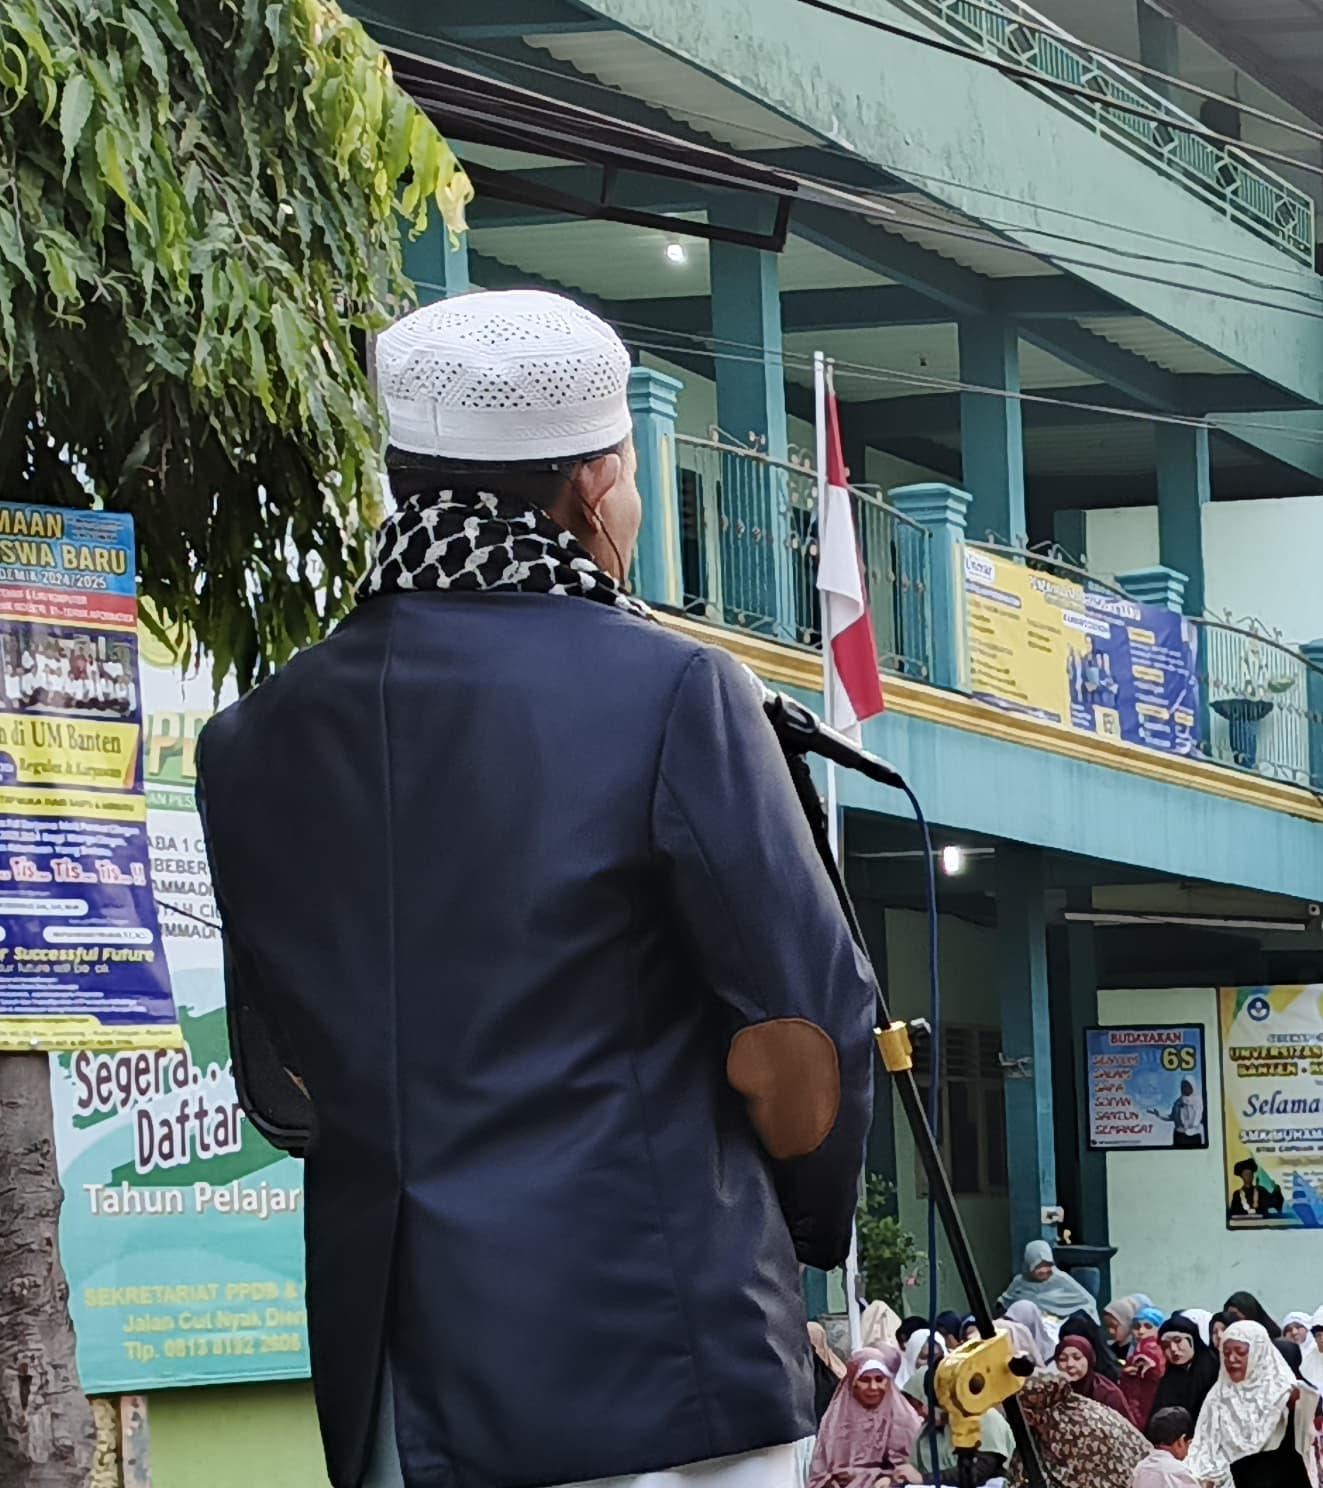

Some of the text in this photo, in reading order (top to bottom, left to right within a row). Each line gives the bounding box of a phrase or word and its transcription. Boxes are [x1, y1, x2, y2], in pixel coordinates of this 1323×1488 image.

[62, 545, 125, 573] BARU
[11, 720, 25, 746] di
[31, 721, 62, 748] UM
[68, 724, 121, 753] Banten
[14, 947, 98, 963] Successful
[102, 948, 154, 962] Future
[1111, 1033, 1181, 1044] BUDAYAKAN
[1163, 1048, 1196, 1070] 6S
[137, 1098, 243, 1167] Daftar
[83, 1182, 300, 1219] Tahun Pelajar
[85, 1283, 219, 1307] SEKRETARIAT
[226, 1282, 277, 1301] PPDB
[124, 1313, 174, 1333] Jalan
[179, 1311, 212, 1329] Cut
[216, 1310, 261, 1332] Nyak
